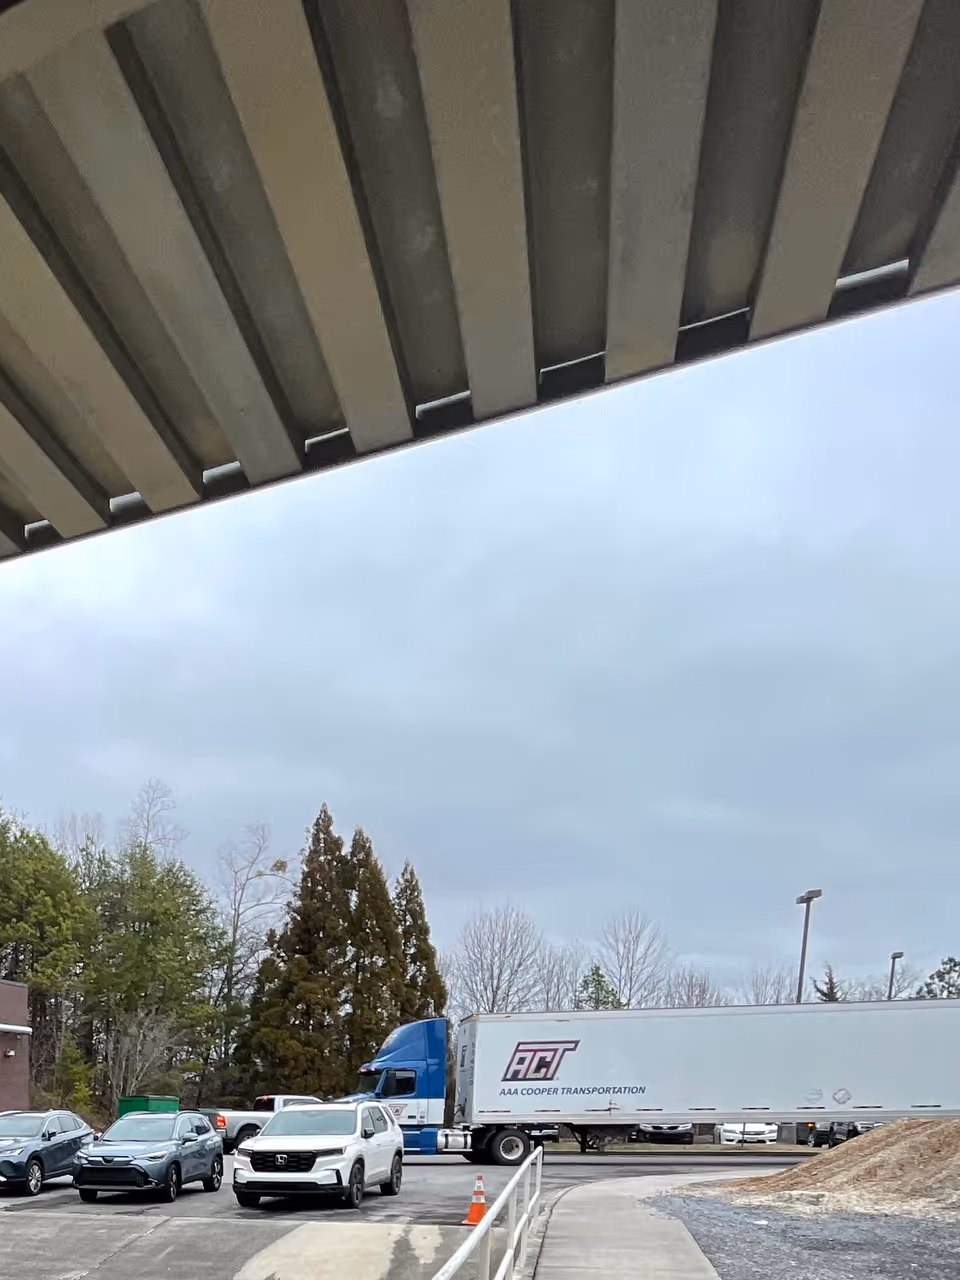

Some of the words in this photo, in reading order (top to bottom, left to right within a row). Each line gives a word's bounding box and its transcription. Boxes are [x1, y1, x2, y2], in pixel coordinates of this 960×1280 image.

[502, 1041, 579, 1081] ACT
[499, 1087, 519, 1096] AAA
[520, 1087, 559, 1096] COOPER
[560, 1086, 646, 1095] TRANSPORTATION
